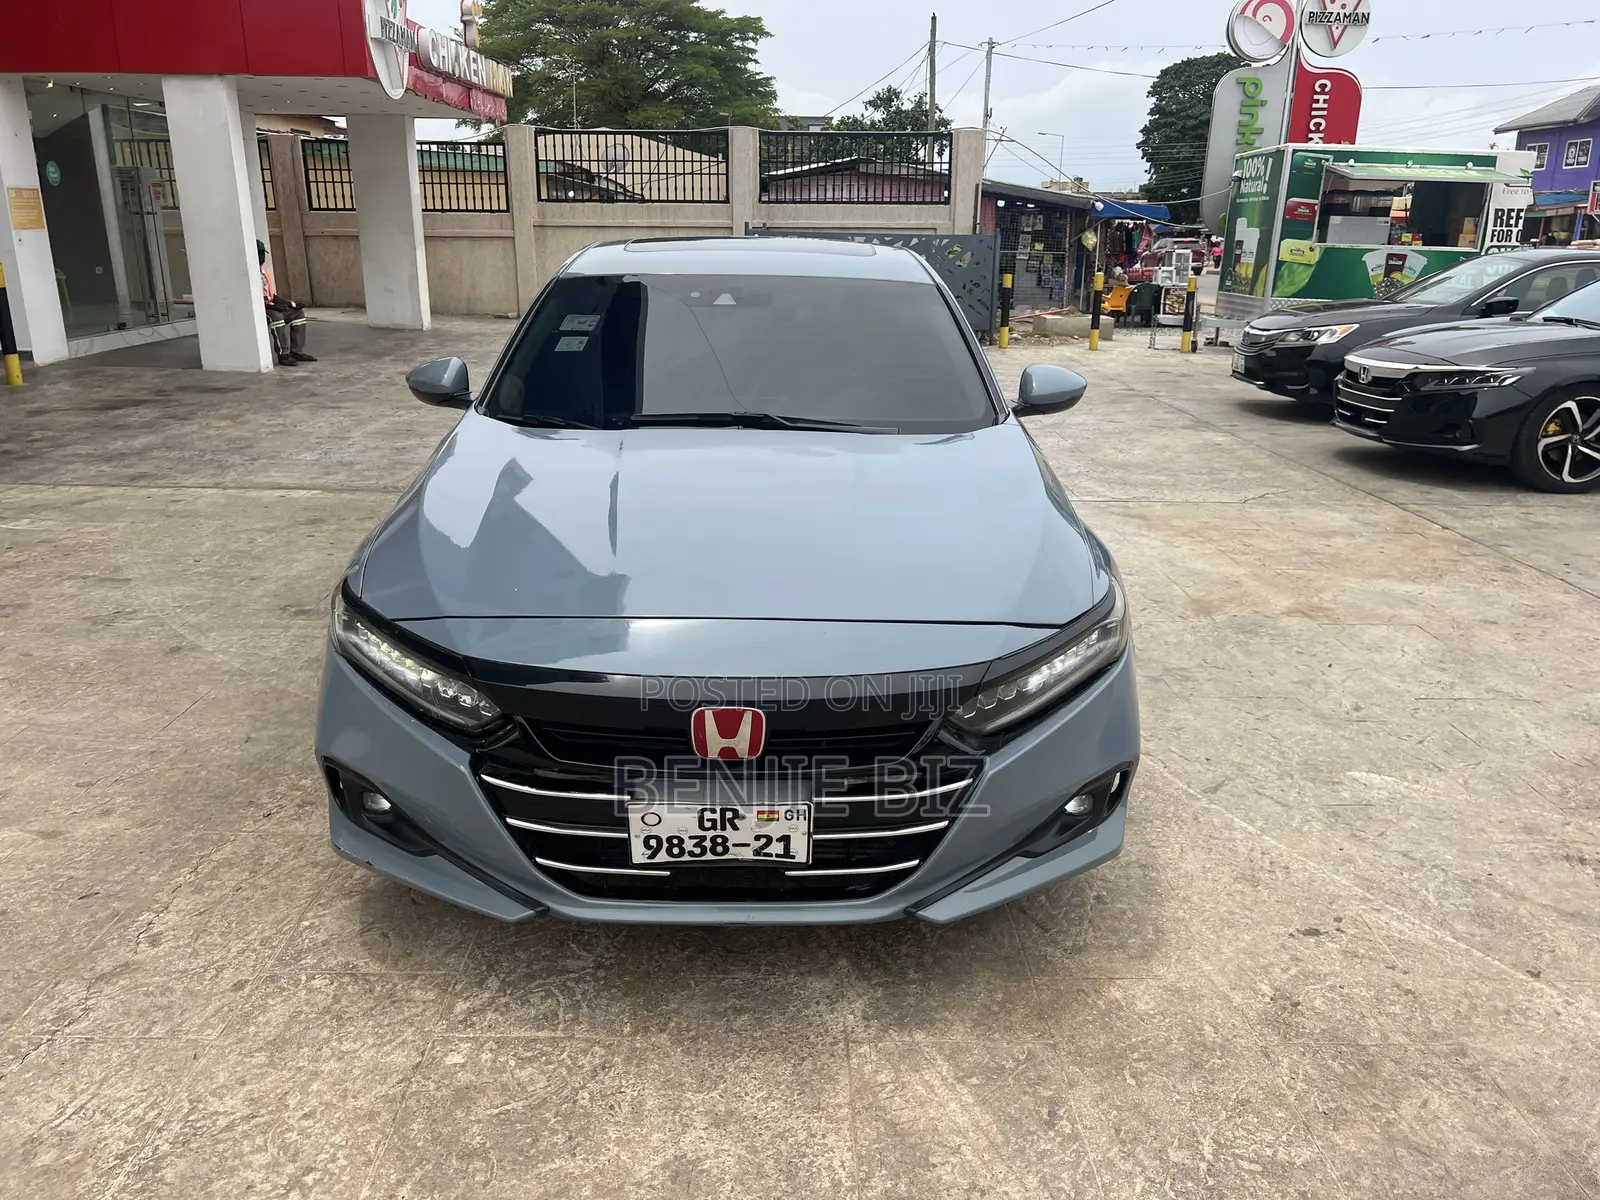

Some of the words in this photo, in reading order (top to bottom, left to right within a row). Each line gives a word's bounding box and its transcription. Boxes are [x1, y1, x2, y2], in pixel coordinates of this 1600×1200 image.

[1307, 11, 1371, 25] PIZZAMAN
[428, 28, 487, 87] CHICKEN
[1242, 155, 1266, 179] 100%
[1490, 229, 1513, 242] FOR
[697, 807, 741, 832] GR
[784, 808, 807, 821] GH
[642, 833, 797, 860] 9838-21
